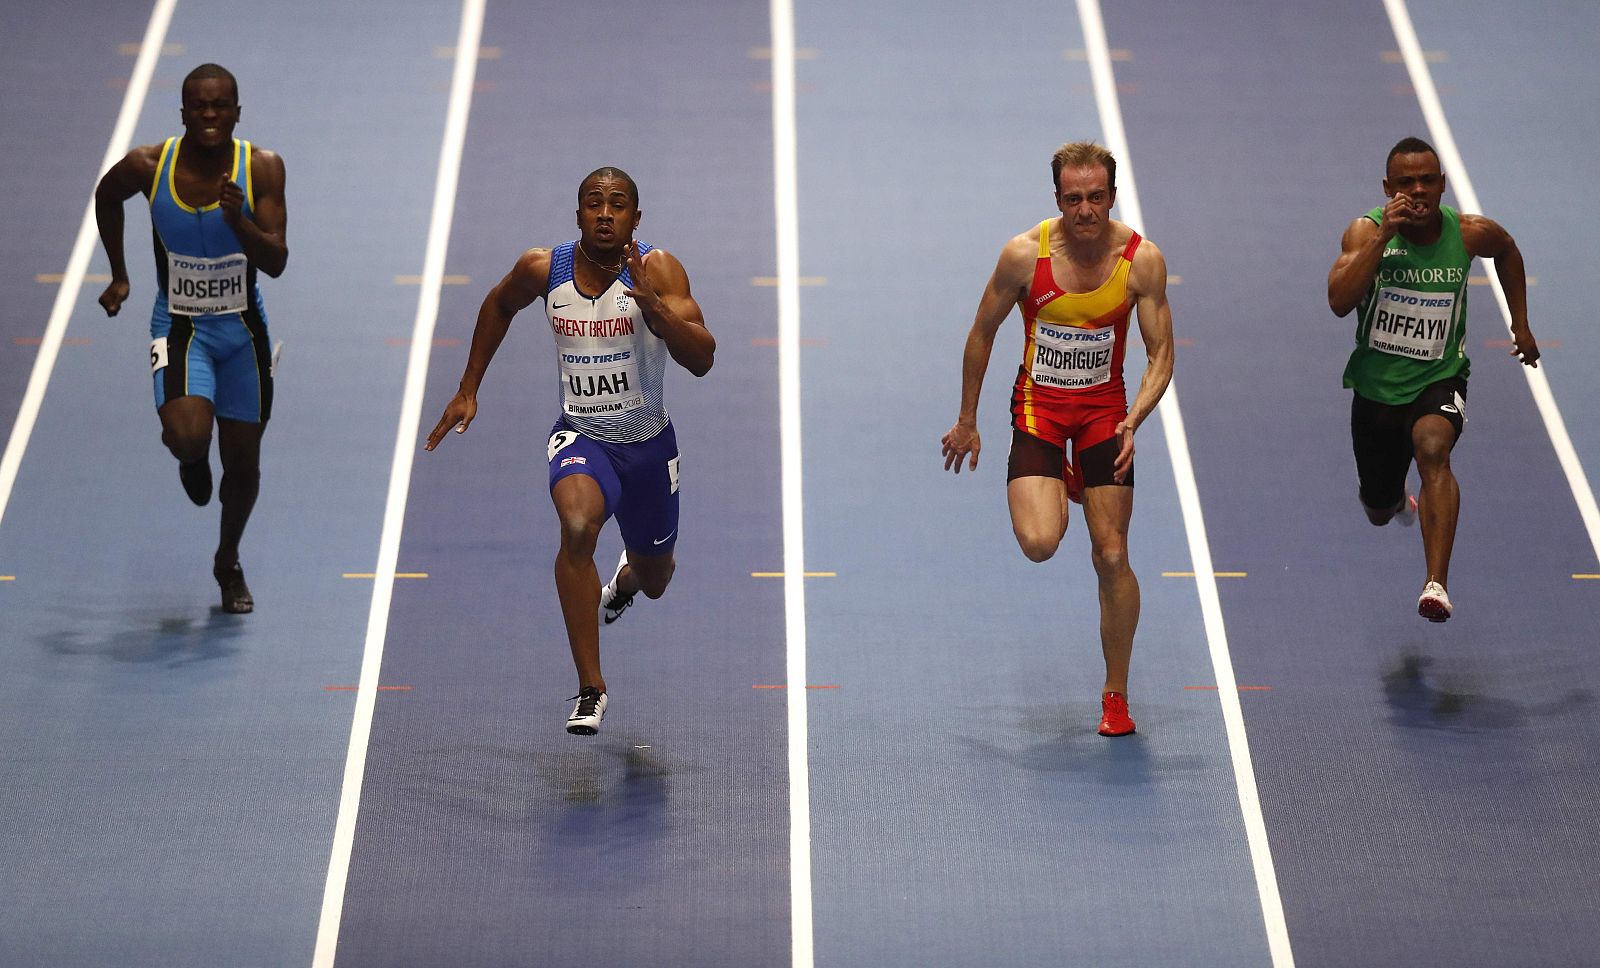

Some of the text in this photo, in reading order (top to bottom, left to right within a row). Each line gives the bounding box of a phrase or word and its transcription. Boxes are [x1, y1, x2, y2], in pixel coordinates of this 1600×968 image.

[173, 259, 244, 271] TOYO TIRES
[1380, 267, 1463, 284] COMORES
[172, 275, 242, 299] JOSEPH
[1035, 290, 1056, 306] Joma
[1383, 291, 1453, 308] TOYO TIRES
[172, 303, 228, 313] BIRMINGHAM
[552, 316, 635, 338] GREAT BRITAIN
[1375, 310, 1447, 340] RIFFAYN
[1040, 326, 1111, 342] TOYO TIRES
[562, 351, 631, 364] TOYO TIRES
[1036, 345, 1111, 370] RODRÍGUEZ
[1373, 340, 1430, 358] BIRMINGHAM
[568, 371, 630, 397] UJAH
[1035, 374, 1093, 386] BIRMINGHAM
[568, 402, 623, 414] BIRMINGHAM
